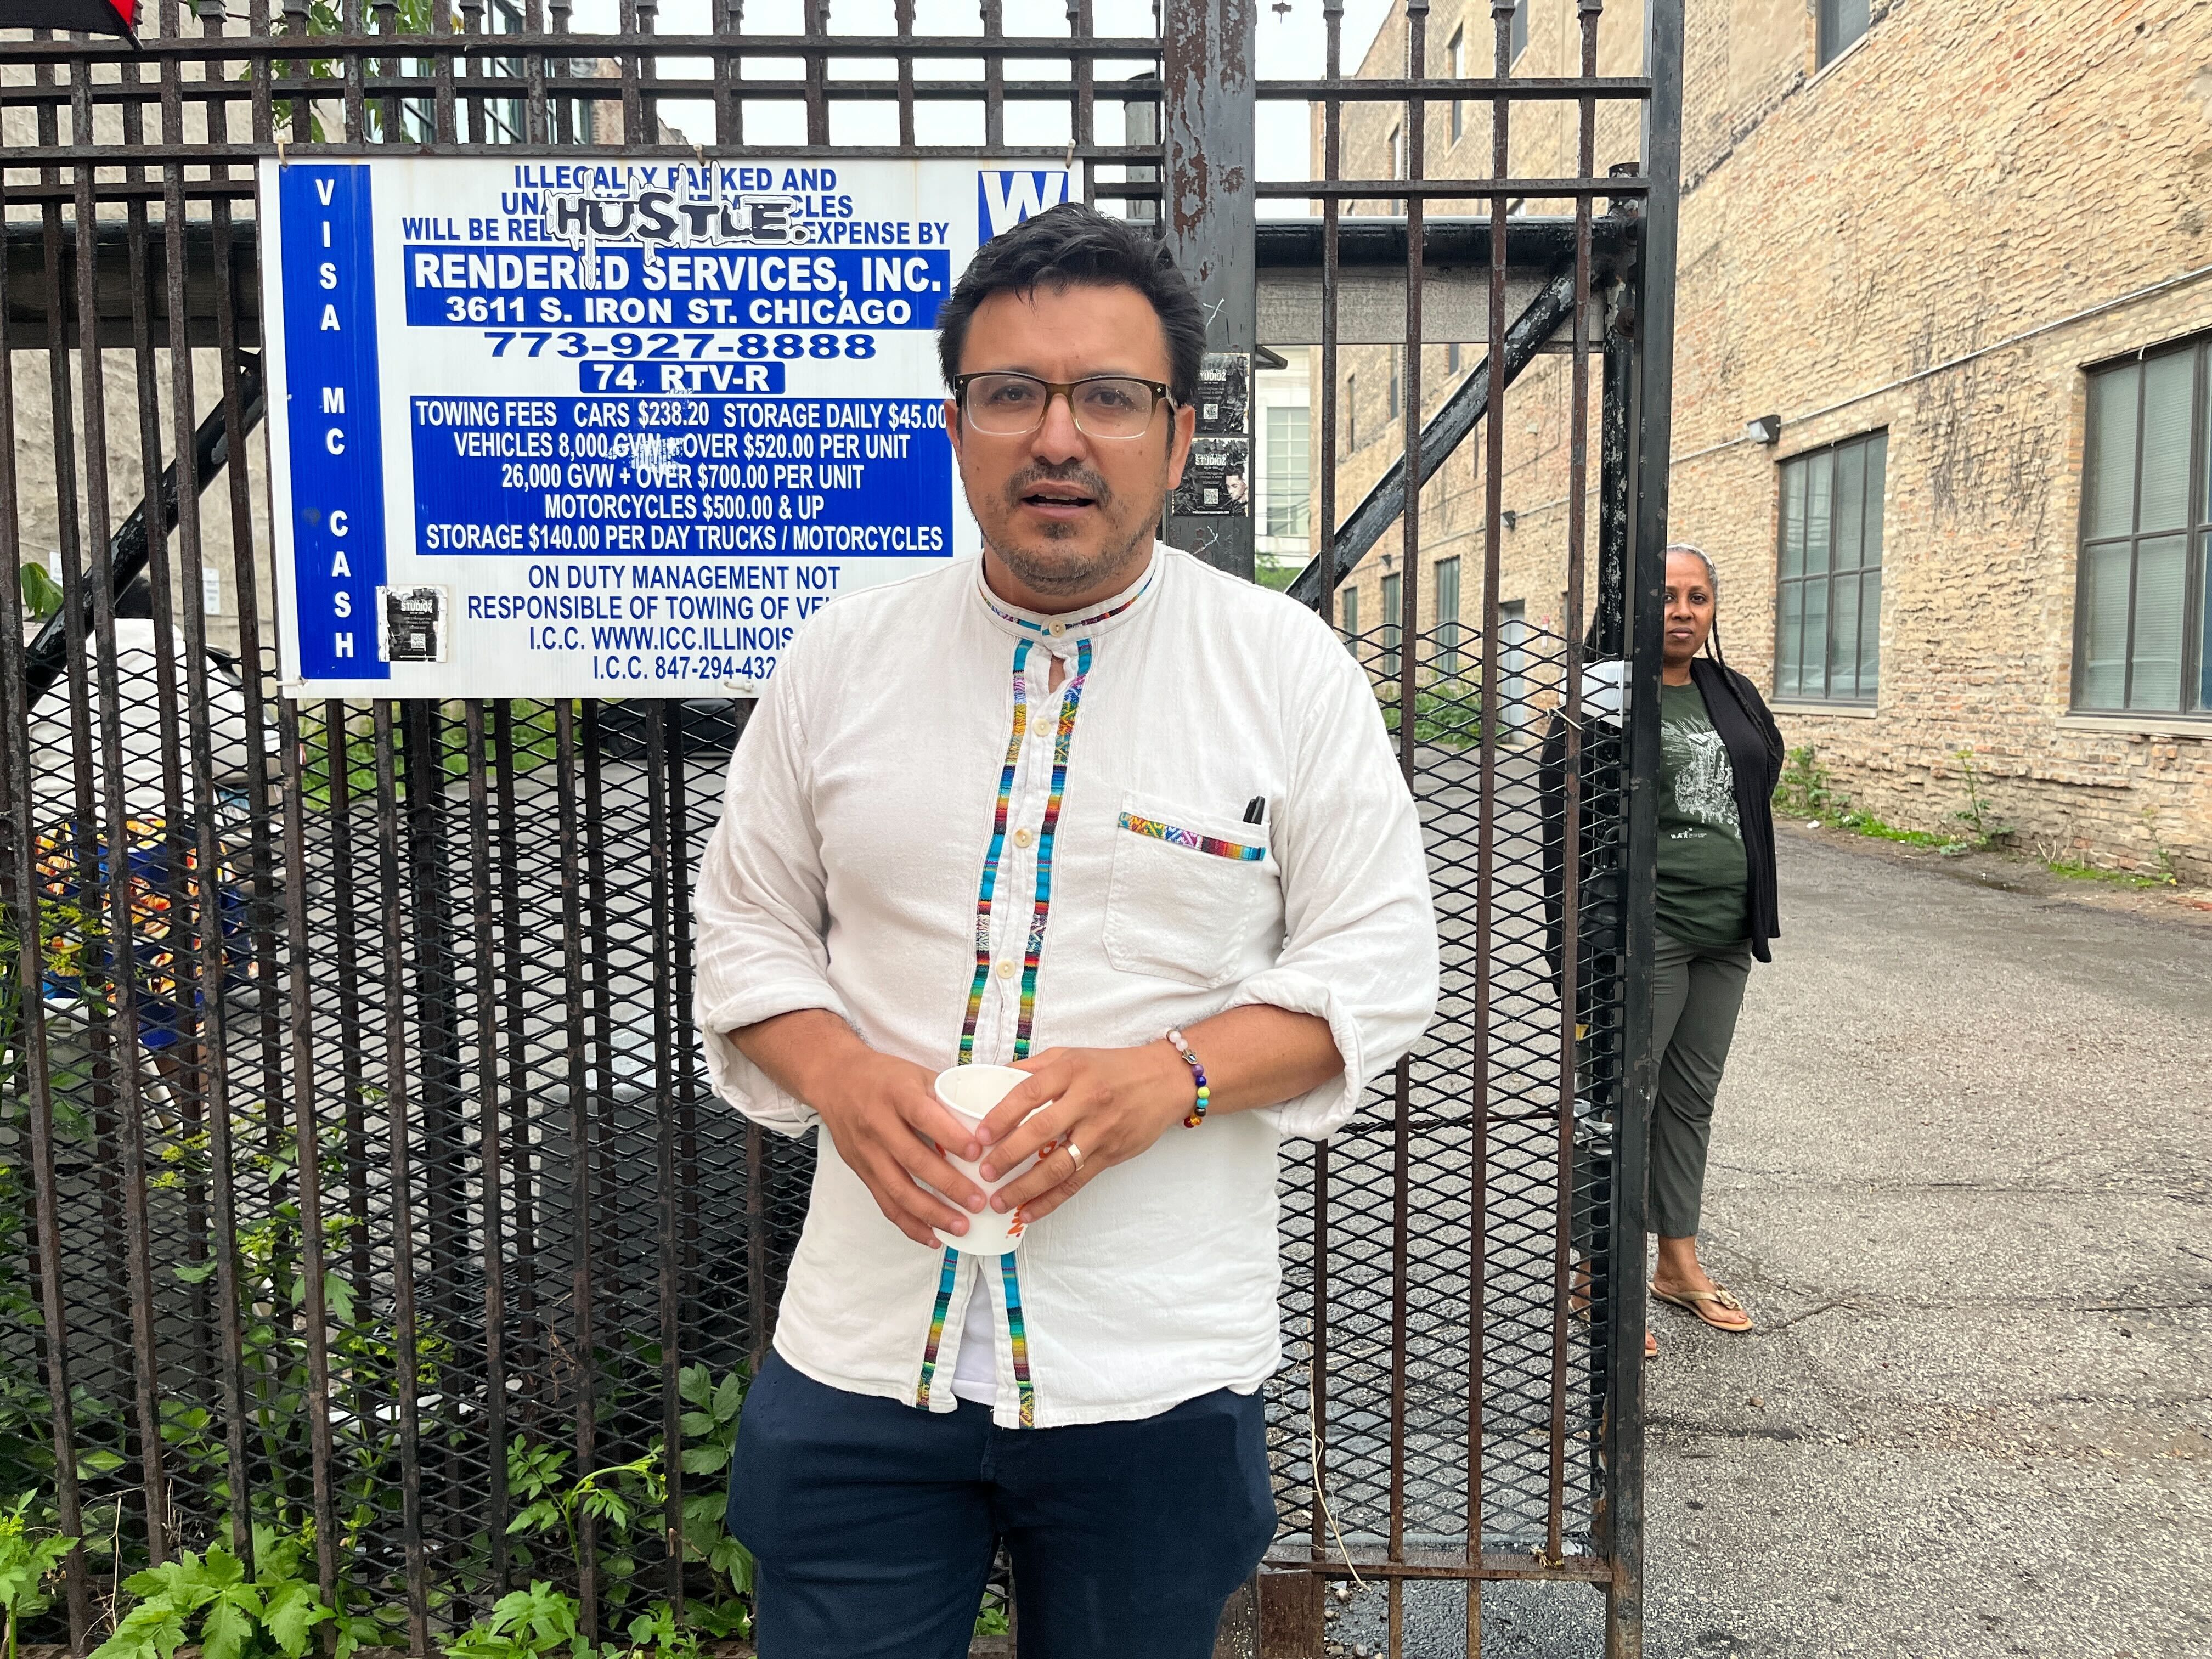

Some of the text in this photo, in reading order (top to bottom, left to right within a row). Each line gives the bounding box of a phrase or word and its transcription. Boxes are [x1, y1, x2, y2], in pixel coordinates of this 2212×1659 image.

[782, 169, 836, 191] AND
[545, 189, 810, 245] HUSTLE.
[981, 172, 1065, 237] W
[402, 218, 460, 240] WILL
[469, 218, 499, 241] BE
[803, 222, 910, 245] EXPENSE
[919, 223, 949, 244] BY
[643, 256, 847, 299] SERVICES,
[863, 257, 940, 292] INC.
[447, 296, 911, 324] 3611 S. IRON ST. CHICAGO
[484, 332, 876, 359] 773-927-8888
[594, 364, 769, 391] 74 RTV-R
[316, 179, 353, 657] VISA MC CASH
[416, 400, 946, 431] TOWING FEES CARS $238.20 STORAGE DAILY $45.00
[454, 432, 552, 456] VEHICLES
[559, 433, 607, 461] 8,000
[683, 433, 738, 458] OVER
[744, 432, 813, 460] $520.00
[821, 435, 860, 458] PER
[866, 435, 910, 458] UNIT
[503, 464, 561, 492] 26,000
[568, 464, 614, 488] GVW
[636, 463, 692, 488] OVER
[698, 463, 768, 491] $700.00
[775, 465, 814, 488] PER
[820, 465, 864, 489] UNIT
[545, 494, 824, 522] MOTORCYCLES $500.00 & UP
[427, 523, 943, 551] STORAGE $140.00 PER DAY TRUCKS / MOTORCYCLES
[529, 565, 840, 589] ON DUTY MANAGEMENT NOT
[469, 596, 829, 619] RESPONSIBLE OF TOWING OF VE
[531, 627, 793, 650] I.C.C. WWW.ICC.ILLINOIS
[594, 656, 776, 679] I.C.C. 847-294-432
